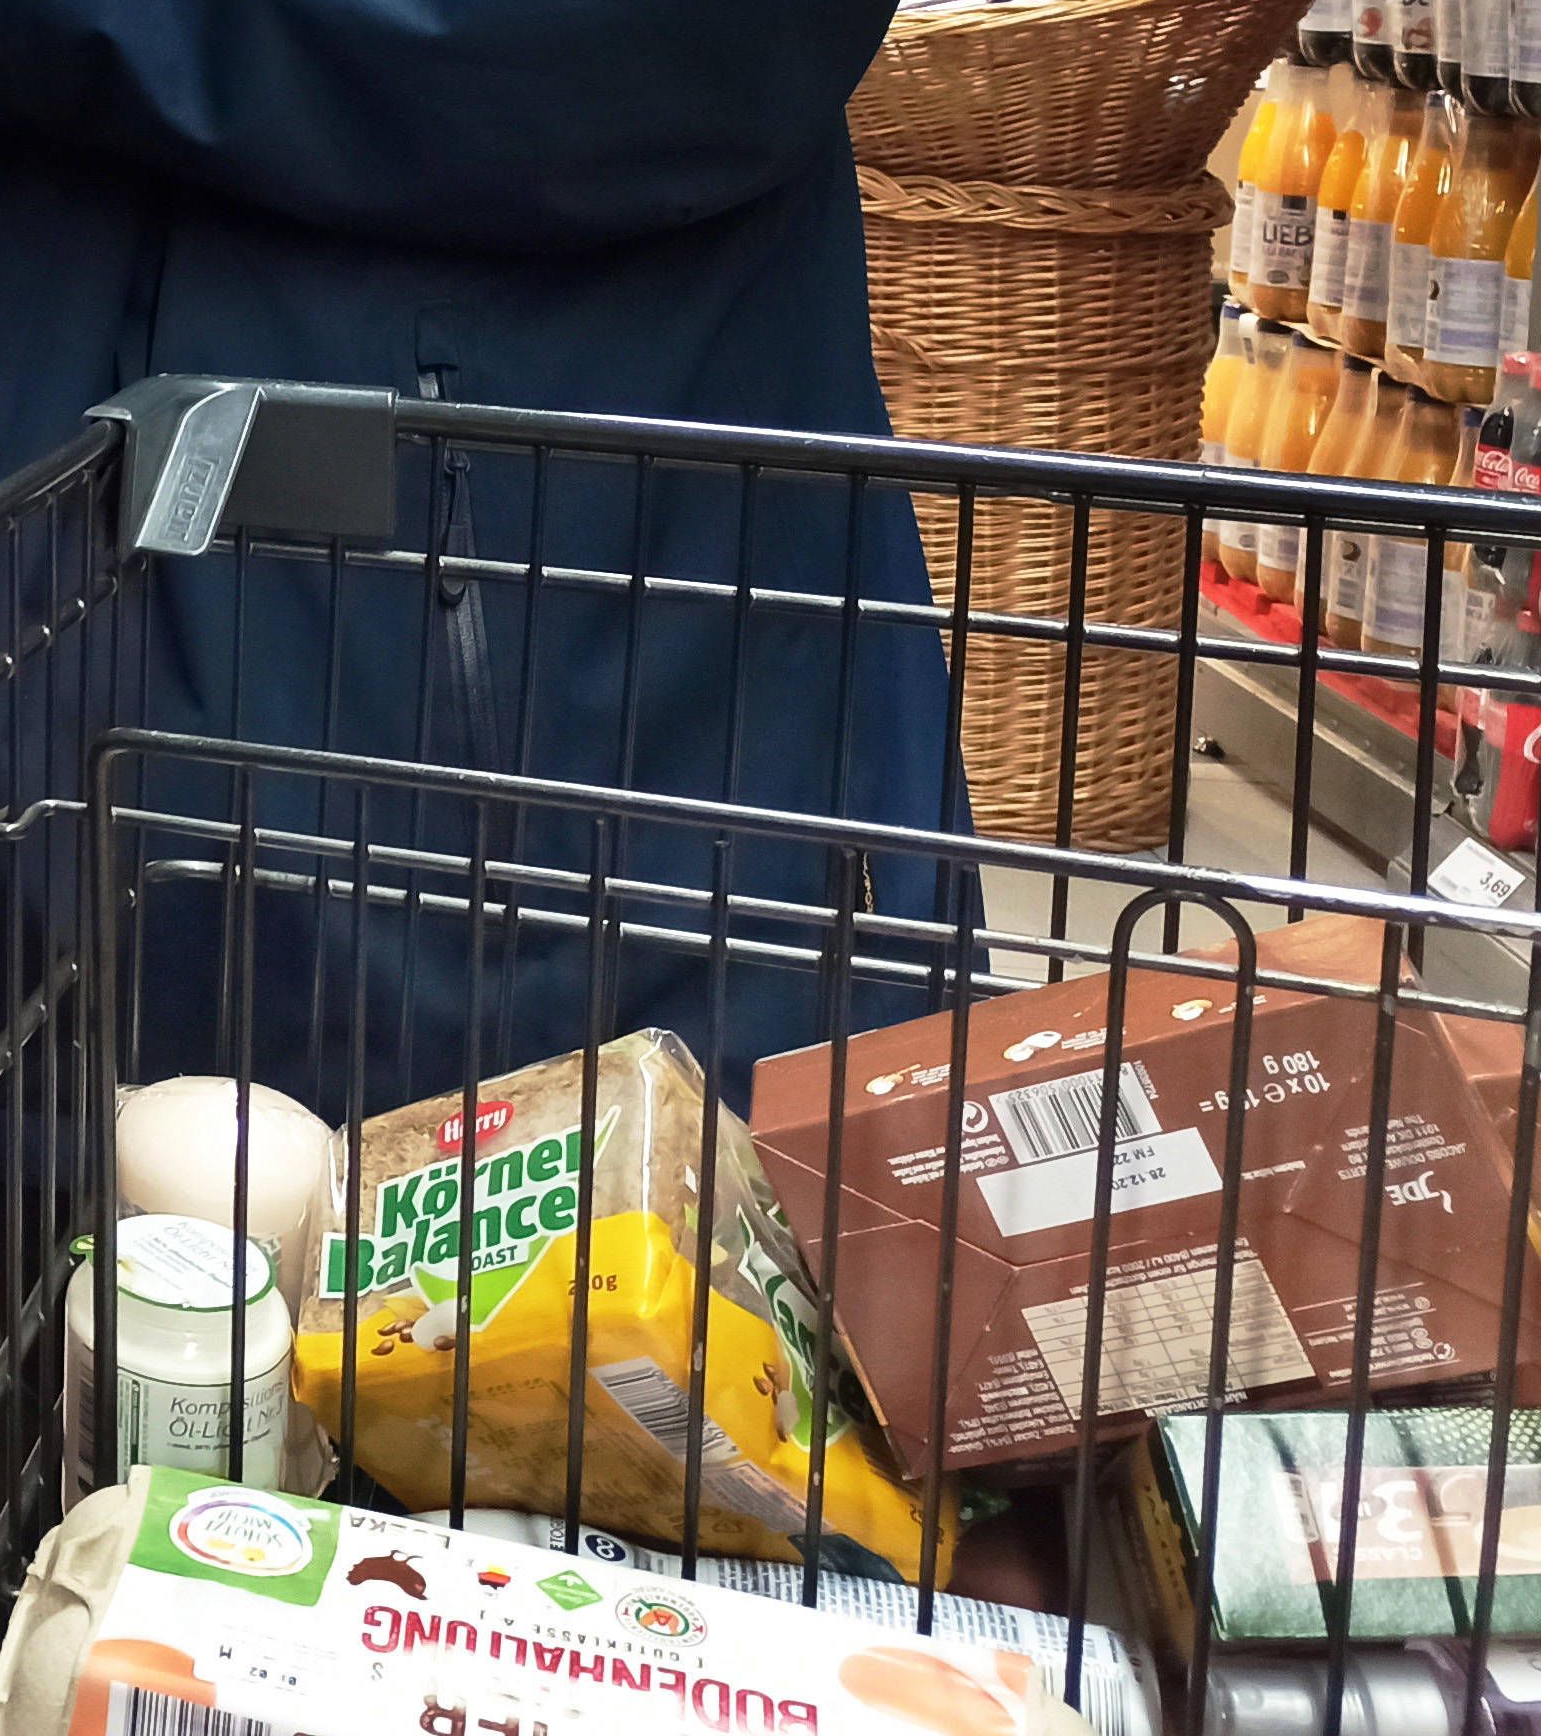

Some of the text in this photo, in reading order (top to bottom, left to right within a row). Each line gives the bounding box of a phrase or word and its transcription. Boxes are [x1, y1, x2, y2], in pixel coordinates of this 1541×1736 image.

[1479, 871, 1511, 898] 3,69
[1262, 1050, 1320, 1075] 180 g
[1285, 1077, 1303, 1094] x
[1304, 1072, 1331, 1094] 10
[443, 1106, 508, 1143] Hrry
[1132, 1145, 1156, 1160] FM
[1384, 1170, 1441, 1206] JDE
[470, 1245, 518, 1272] OAST
[567, 1273, 618, 1296] 20g
[218, 1645, 233, 1660] M
